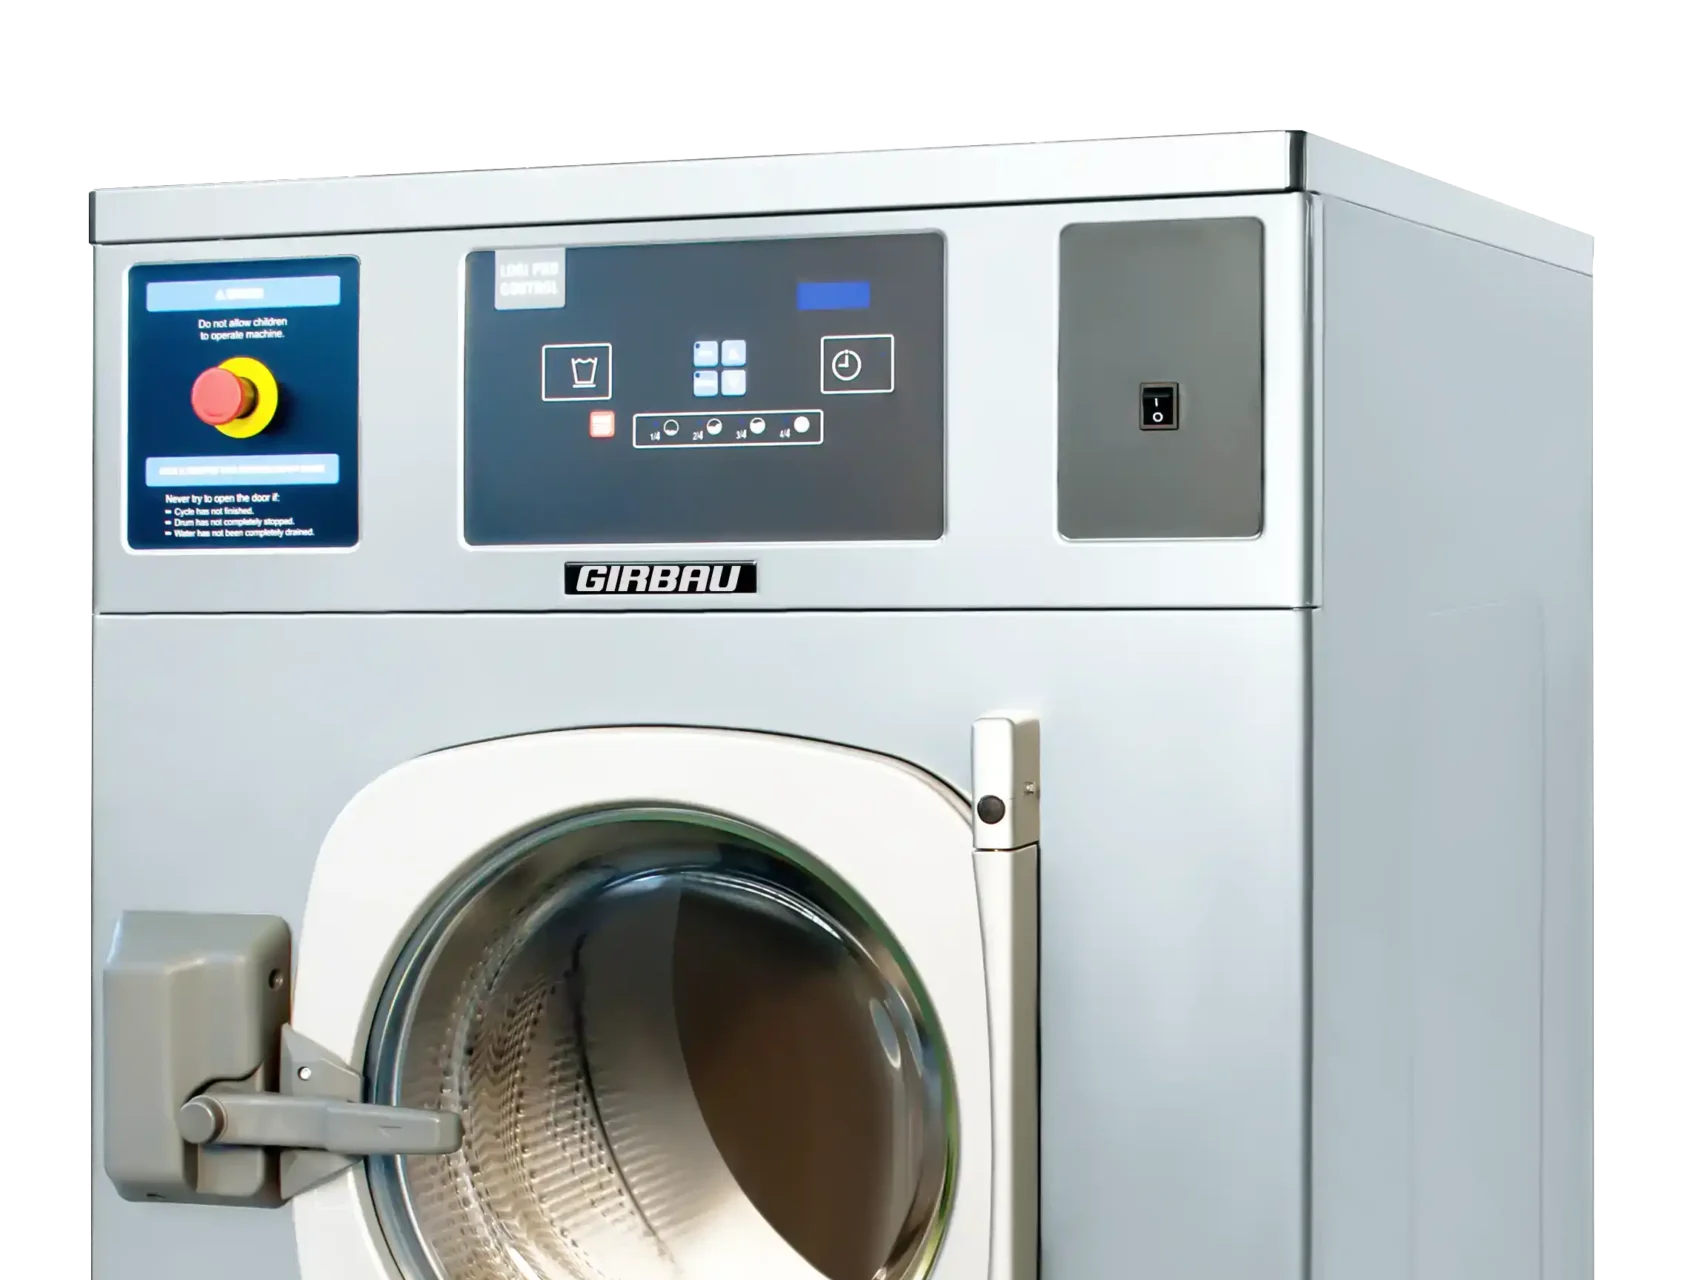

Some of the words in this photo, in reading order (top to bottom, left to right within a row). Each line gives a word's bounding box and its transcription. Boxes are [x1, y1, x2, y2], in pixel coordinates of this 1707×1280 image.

[198, 319, 211, 329] Do
[213, 319, 227, 328] not
[229, 318, 251, 328] allow
[253, 317, 287, 327] children
[200, 330, 209, 340] to
[211, 331, 244, 341] operate
[246, 329, 285, 339] machine.
[650, 431, 660, 441] 1/4
[692, 430, 703, 440] 2/4
[736, 429, 747, 439] 3/4
[165, 494, 190, 503] Never
[191, 494, 202, 505] try
[204, 494, 212, 503] to
[214, 495, 235, 504] open
[236, 493, 250, 502] the
[251, 493, 271, 502] door
[174, 508, 195, 517] Cycle
[196, 507, 209, 515] has
[211, 507, 223, 515] not
[224, 506, 254, 515] finished.
[174, 518, 194, 527] Drum
[195, 518, 209, 526] has
[210, 518, 222, 526] not
[223, 517, 262, 527] completely
[263, 516, 295, 527] stopped.
[174, 529, 195, 537] Water
[196, 529, 210, 537] has
[225, 528, 244, 537] been
[245, 528, 284, 538] completely
[285, 527, 315, 536] drained.
[576, 565, 741, 592] GIRBAU
